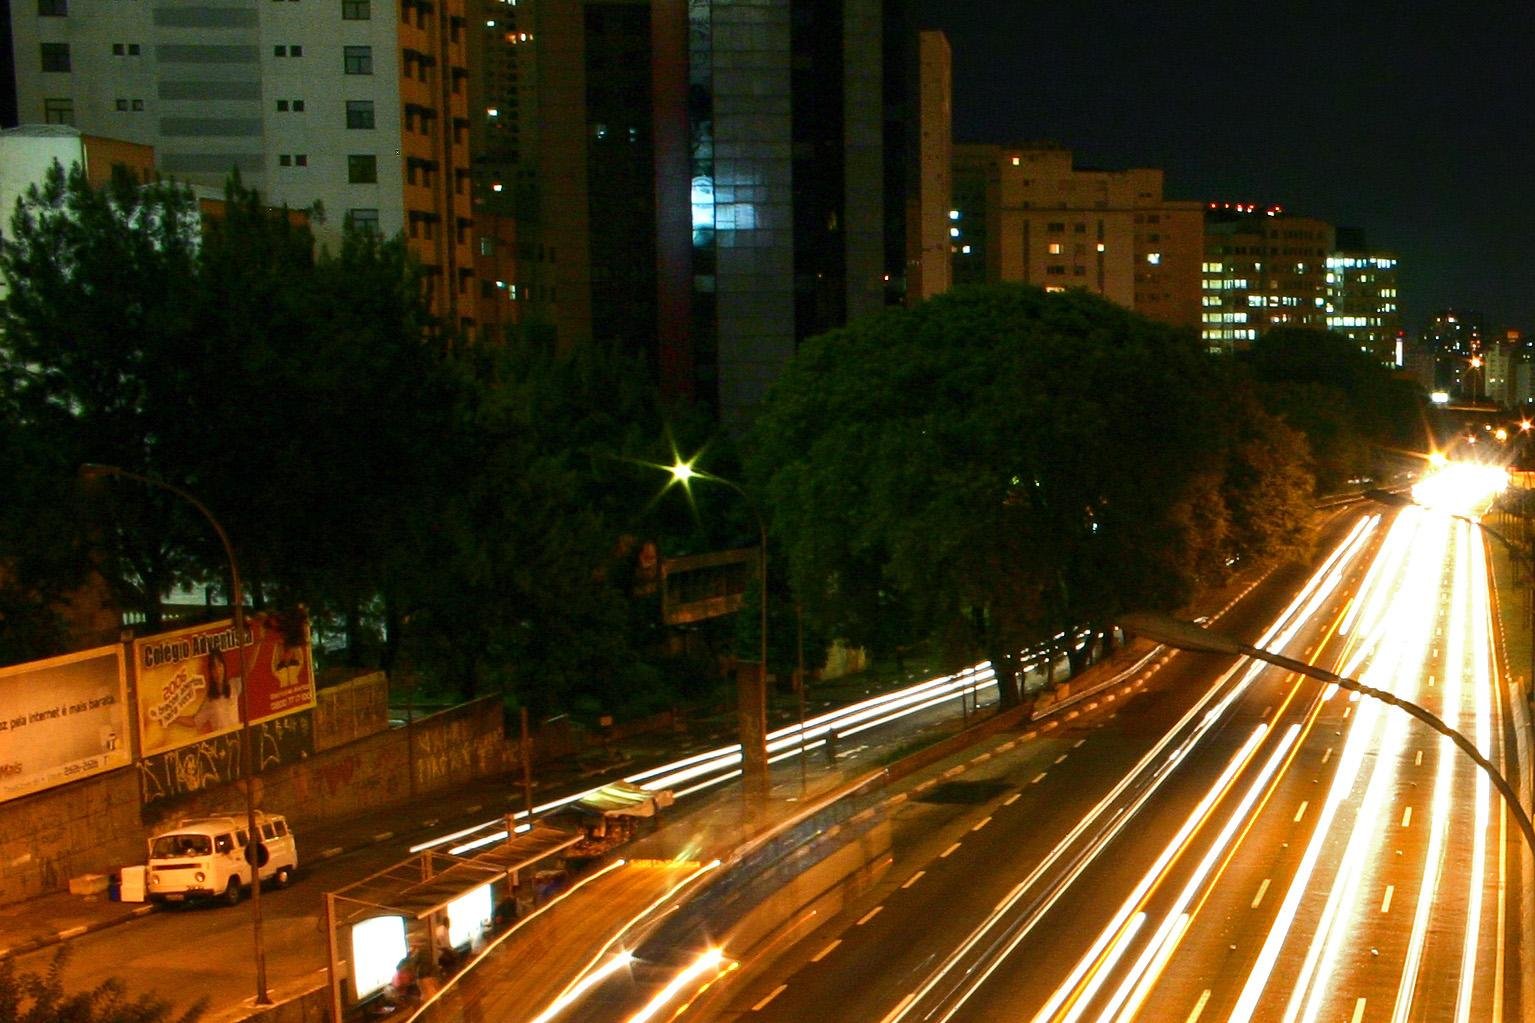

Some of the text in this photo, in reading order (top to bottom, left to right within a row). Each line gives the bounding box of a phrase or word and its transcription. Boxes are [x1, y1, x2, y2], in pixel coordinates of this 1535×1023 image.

[10, 714, 27, 731] pela
[28, 706, 60, 723] internet
[61, 703, 68, 717] é
[68, 701, 88, 715] mais
